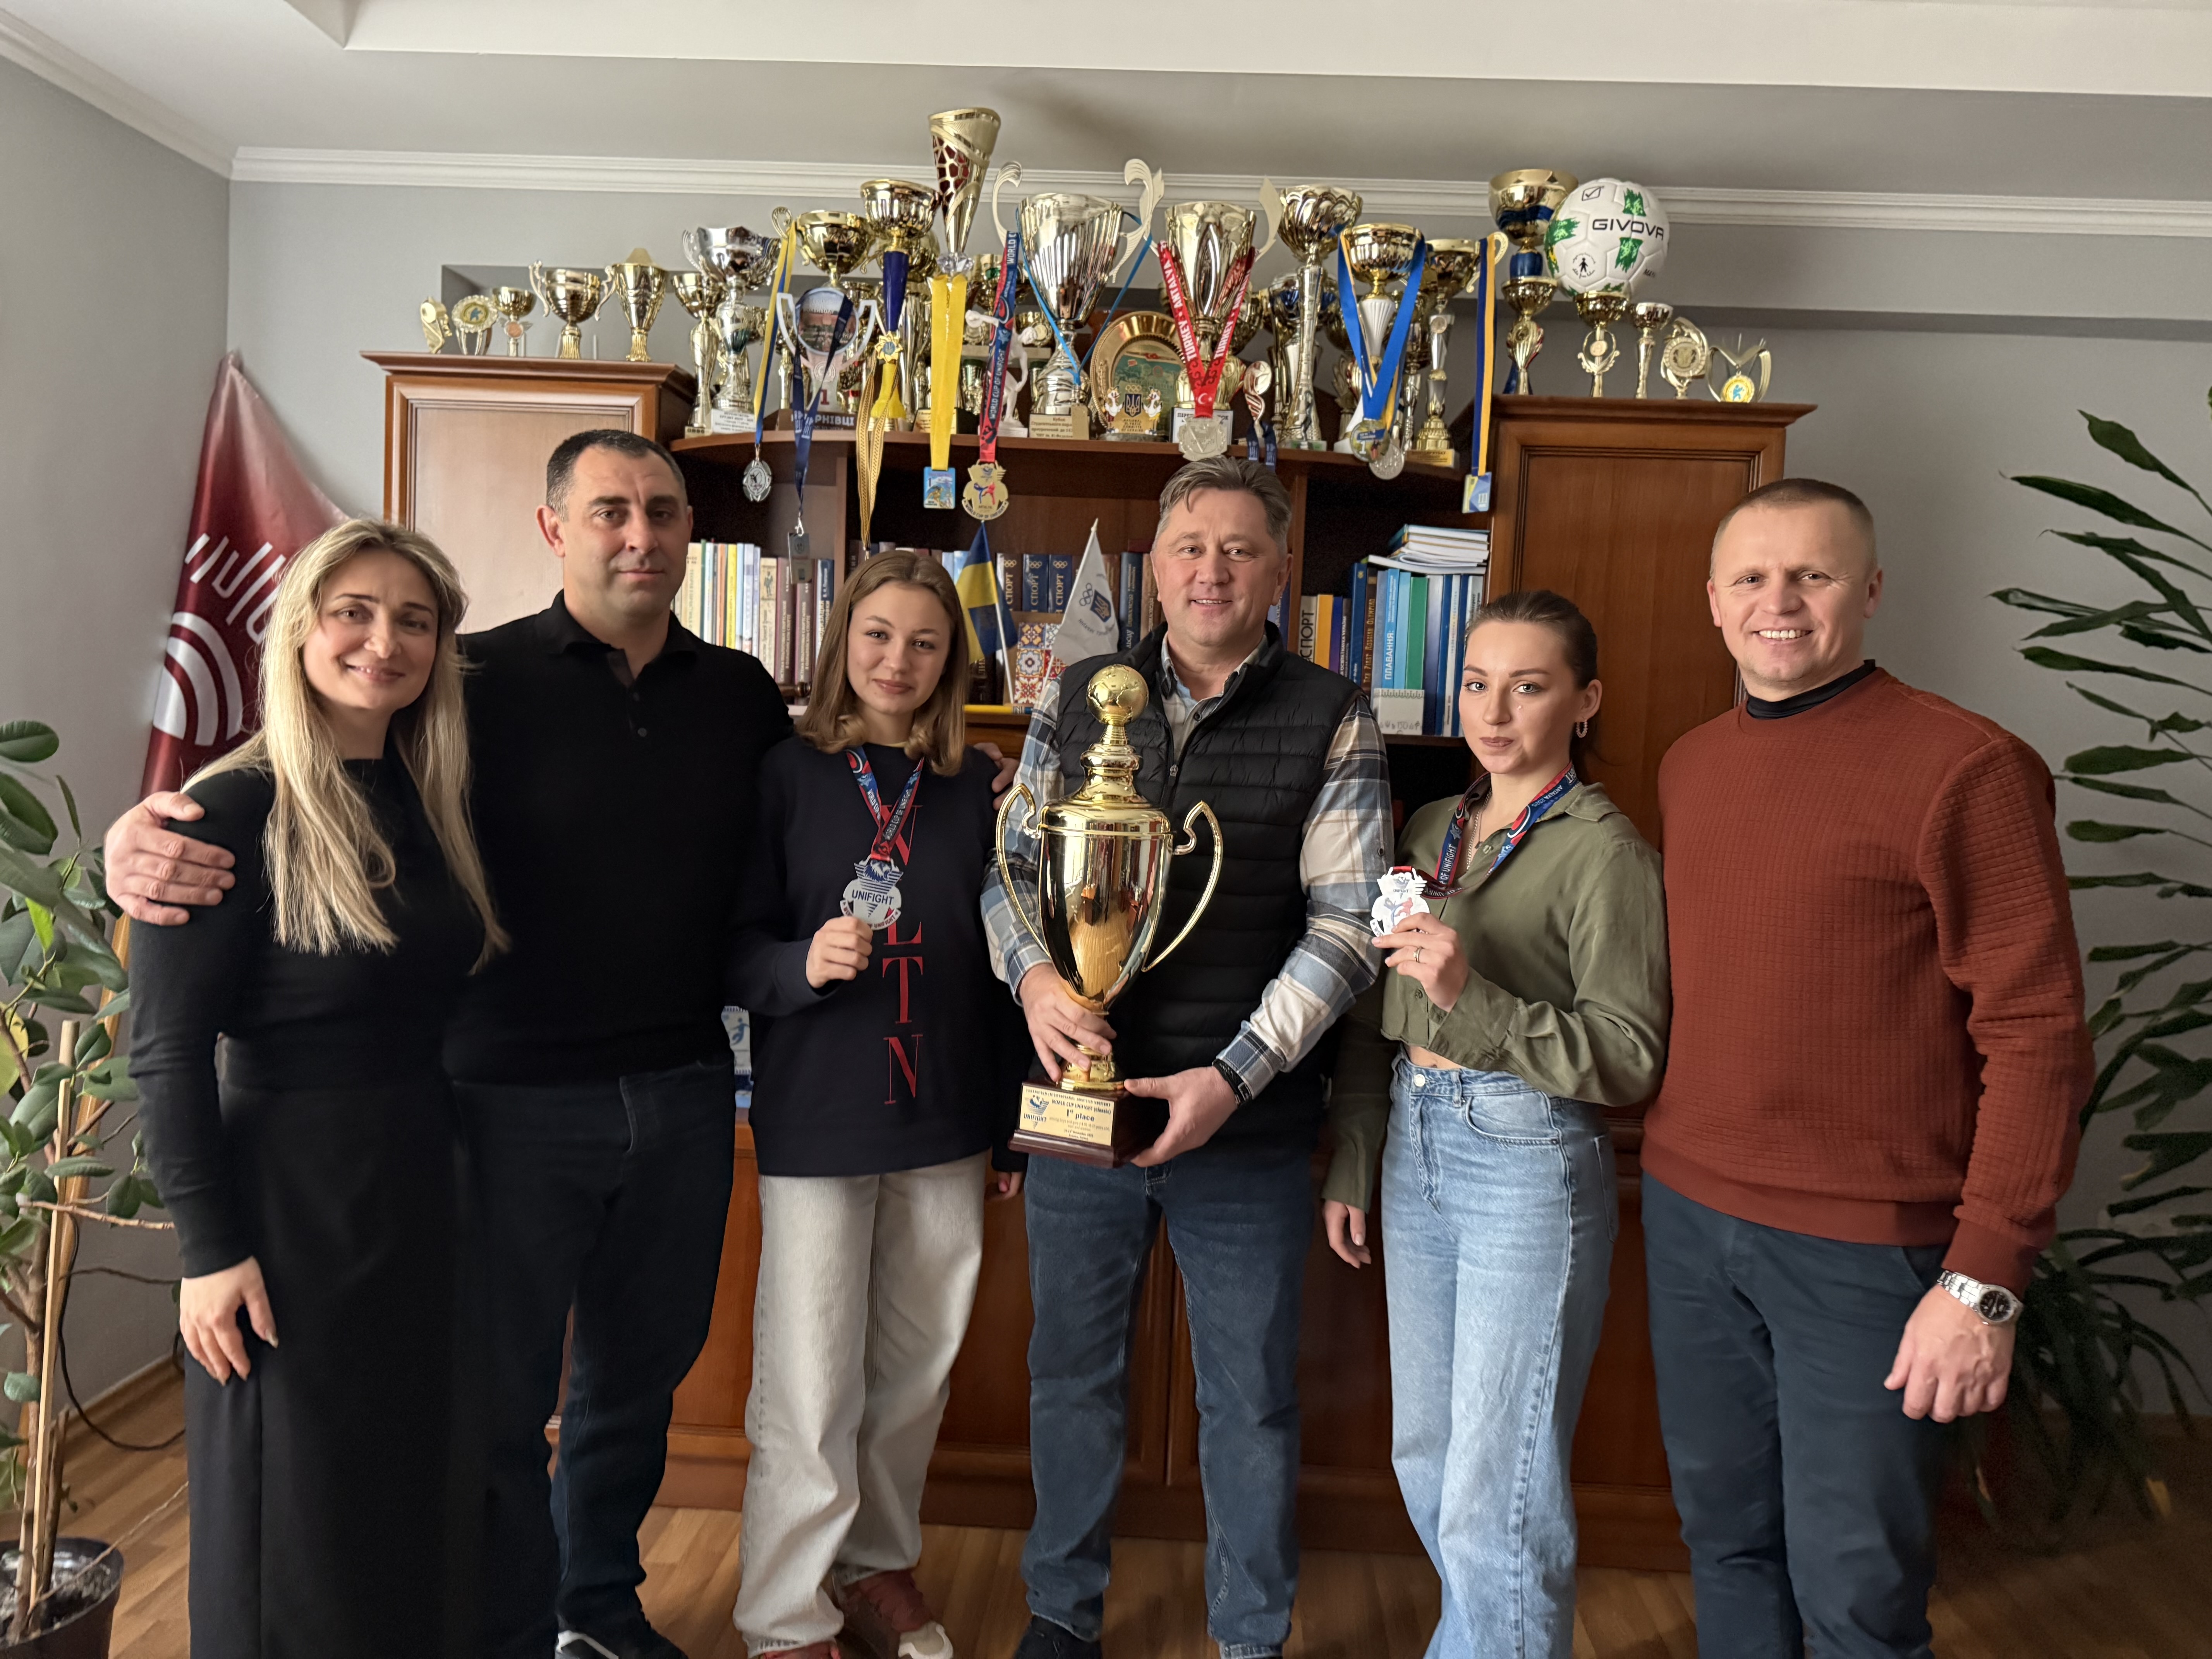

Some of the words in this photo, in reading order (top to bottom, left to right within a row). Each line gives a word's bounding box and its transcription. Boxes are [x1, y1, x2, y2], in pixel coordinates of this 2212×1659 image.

[1592, 219, 1664, 240] GIVOVA
[1007, 239, 1016, 264] WORLD
[1163, 259, 1183, 309] ANTALYA
[1178, 320, 1197, 361] TURKEY
[1214, 321, 1233, 359] TURKEY
[996, 349, 1005, 376] UNIFIGHT
[994, 376, 1001, 385] OF
[989, 398, 999, 419] WORLD
[1359, 441, 1367, 454] 1
[1300, 610, 1314, 658] СПОРТ
[1384, 630, 1394, 680] ПЛАВАННЯ:
[1543, 785, 1563, 799] ANTALYA
[1443, 843, 1456, 872] UNIFIGHT
[852, 889, 894, 905] UNIFIGHT
[874, 914, 895, 928] UNIFIGHT
[1024, 1113, 1046, 1123] UNIFIGHT
[1075, 1113, 1095, 1121] place
